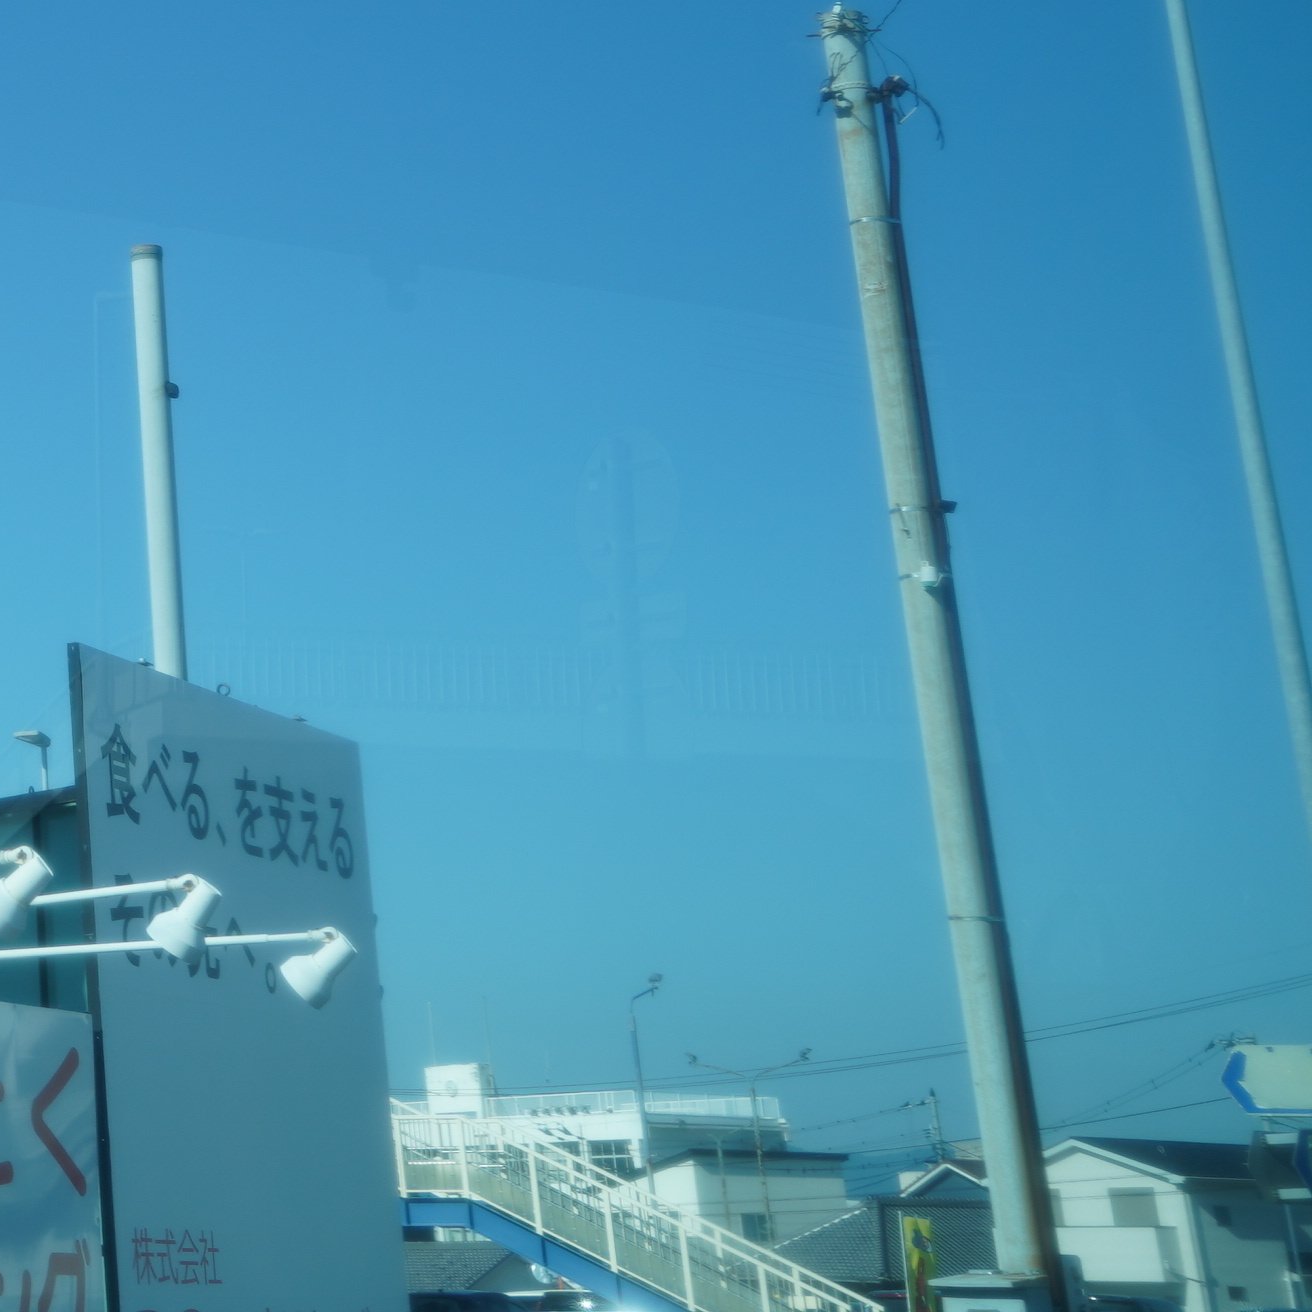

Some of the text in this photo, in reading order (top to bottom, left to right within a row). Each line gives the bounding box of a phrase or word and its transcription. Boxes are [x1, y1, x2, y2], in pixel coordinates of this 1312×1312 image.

[100, 723, 355, 879] 食べる、を支える
[131, 1227, 223, 1285] 株式会社
